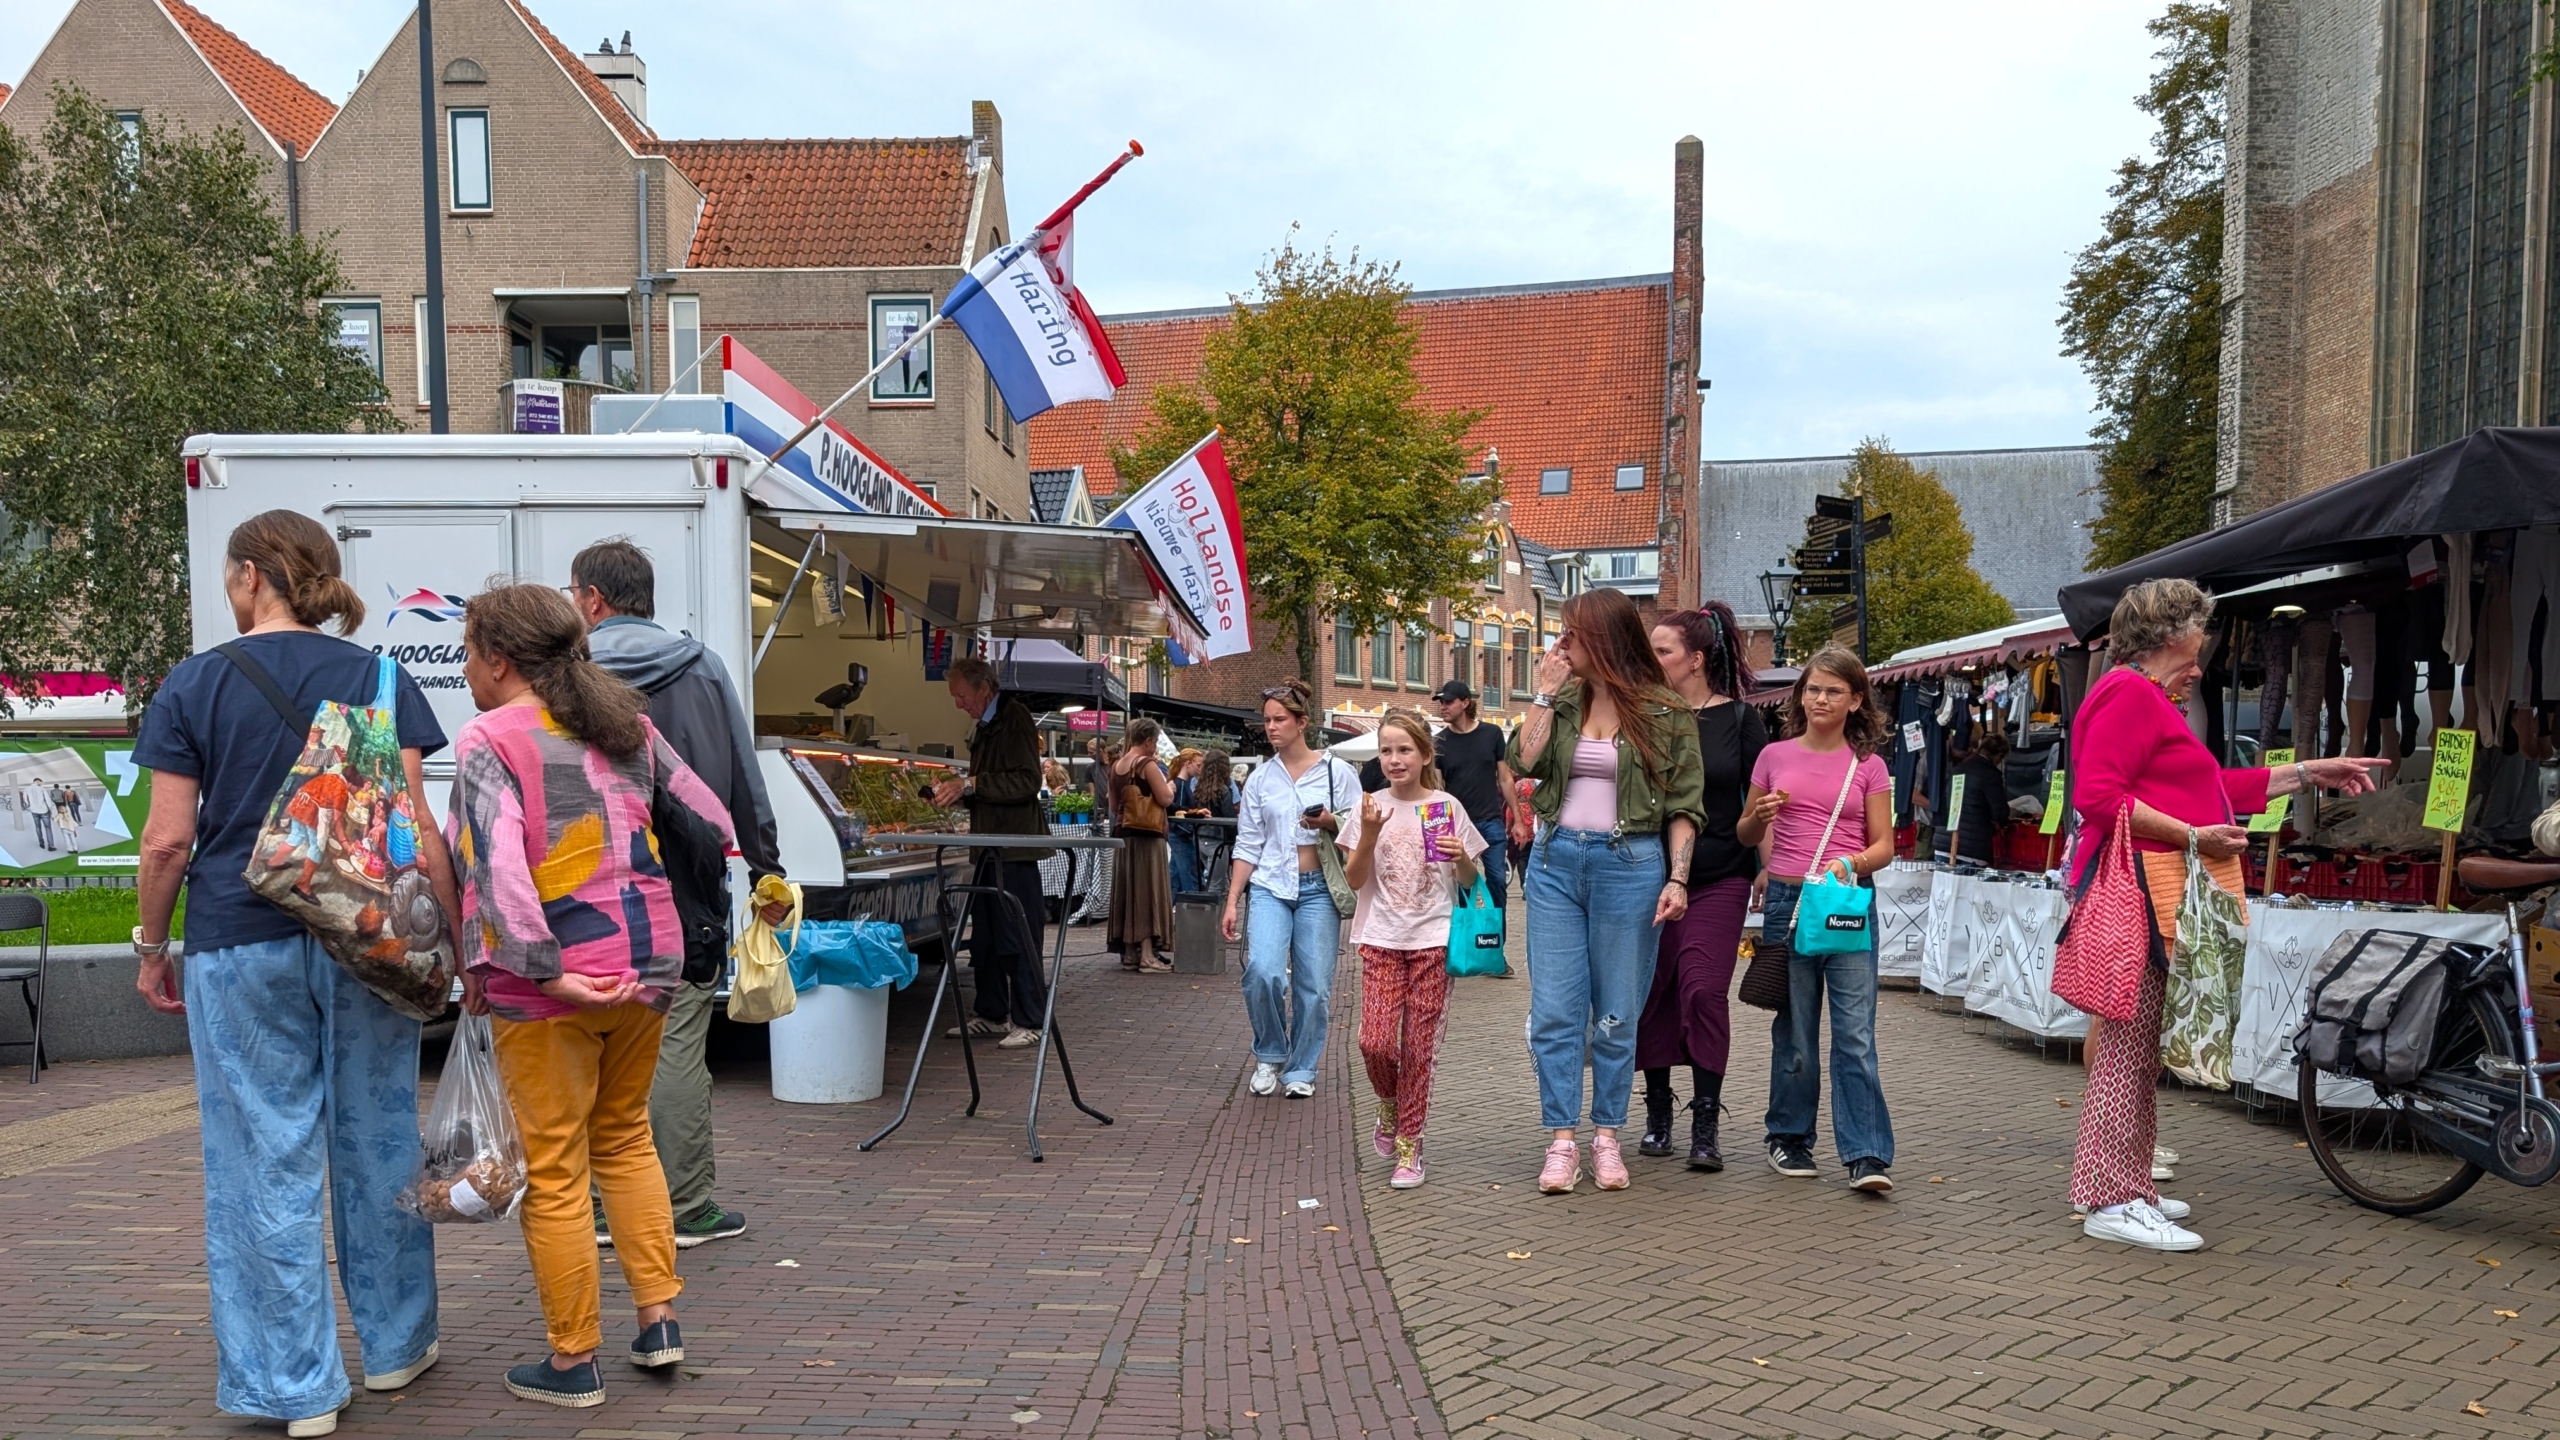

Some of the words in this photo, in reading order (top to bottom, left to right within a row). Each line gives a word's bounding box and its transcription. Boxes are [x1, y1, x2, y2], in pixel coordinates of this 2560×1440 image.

[1010, 272, 1077, 366] Haring
[349, 322, 367, 332] koop
[538, 383, 557, 394] koop
[1171, 478, 1234, 631] Hollandse
[1143, 499, 1182, 557] Nieuwe
[1179, 565, 1206, 625] Harin
[388, 644, 468, 665] HOOGLA
[1072, 718, 1104, 726] Pinocco
[1423, 815, 1450, 829] Skittles
[895, 883, 920, 923] VOOR
[1829, 916, 1863, 928] Normal
[1477, 934, 1499, 946] Normal
